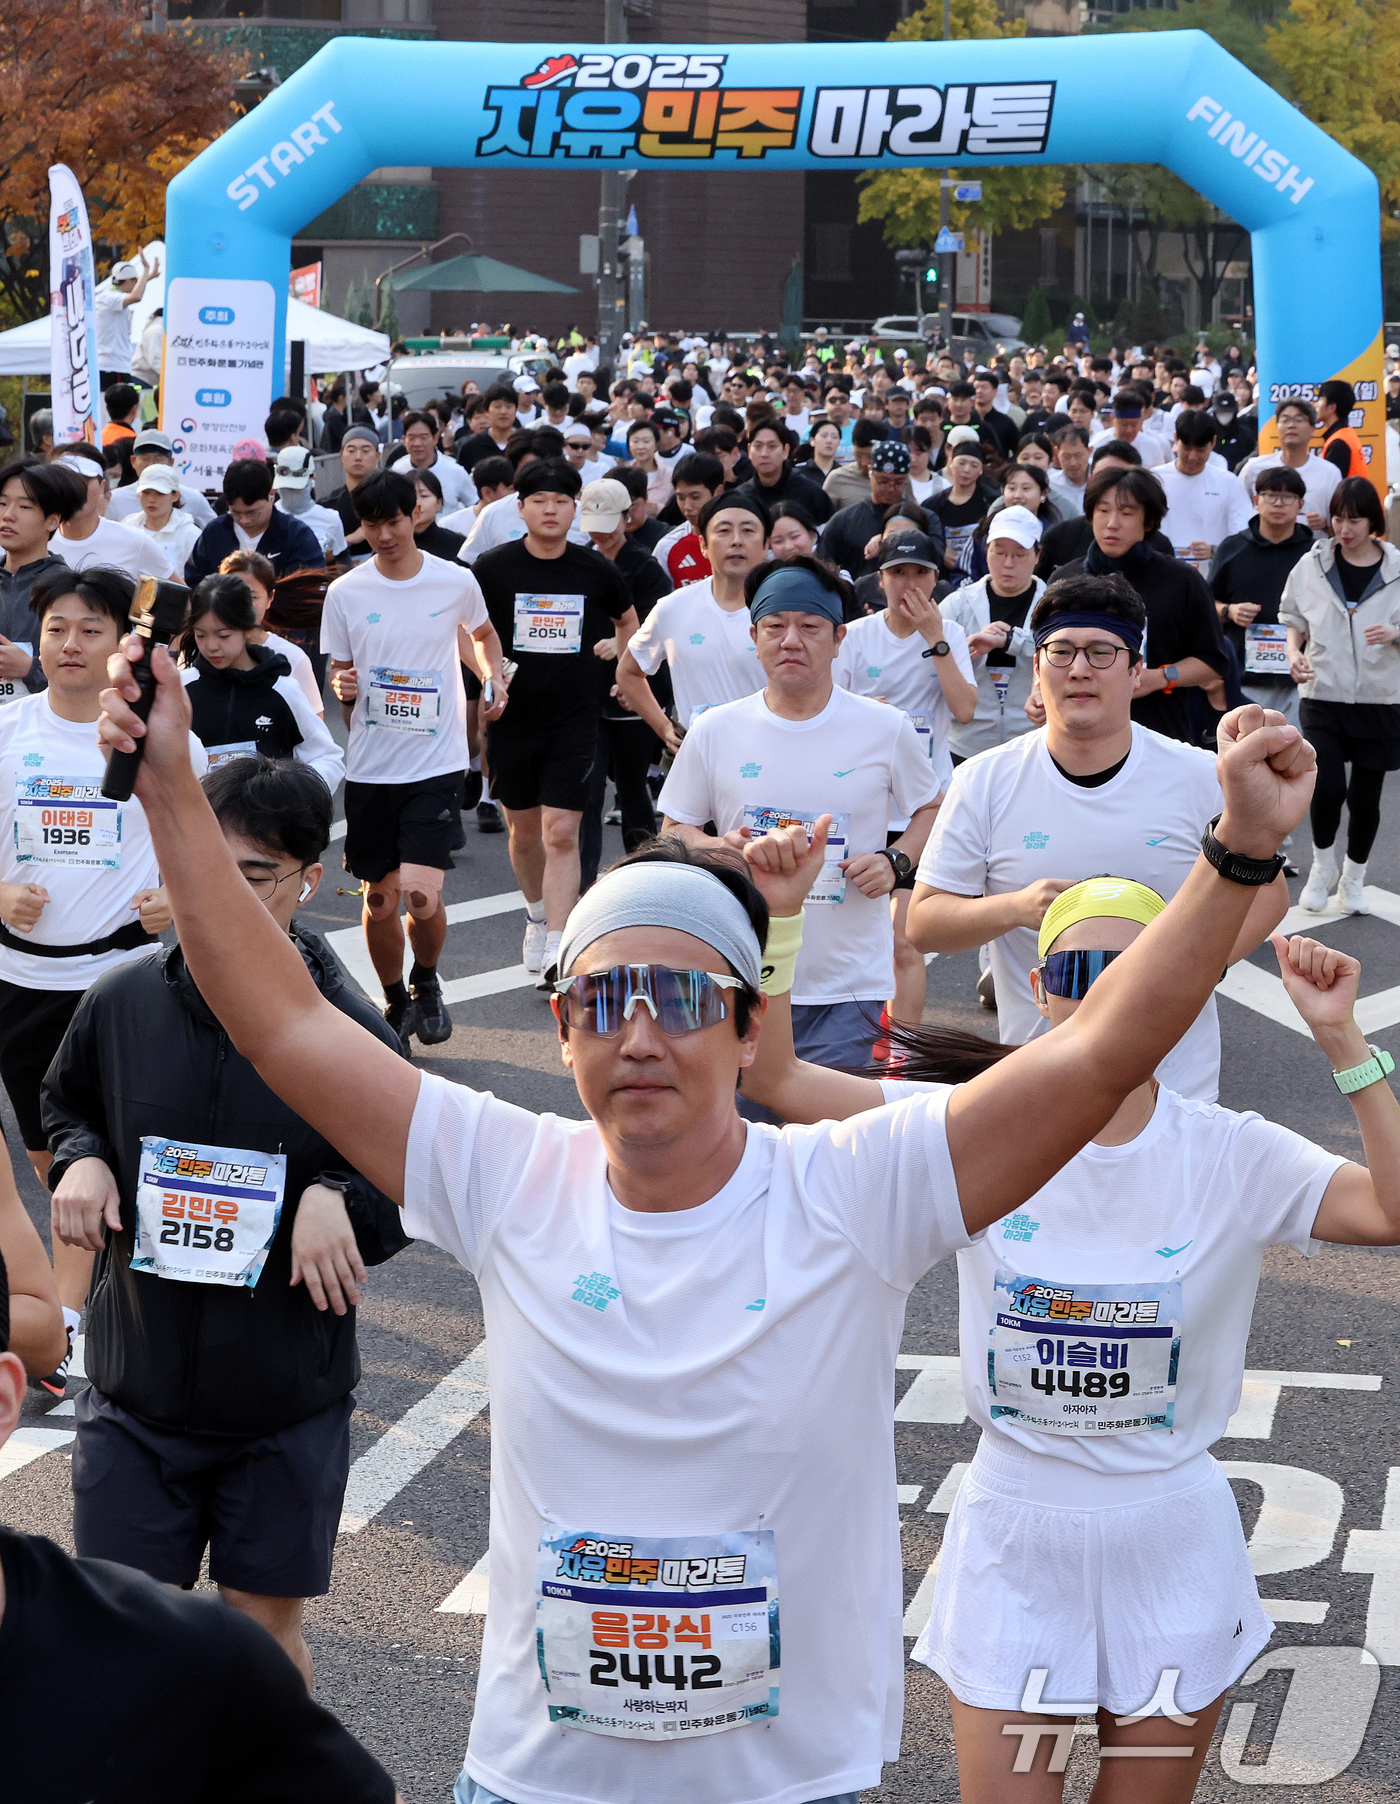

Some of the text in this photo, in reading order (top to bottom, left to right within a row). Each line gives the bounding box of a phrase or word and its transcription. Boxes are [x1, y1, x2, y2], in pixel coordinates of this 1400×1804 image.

[574, 54, 728, 89] 2025
[477, 82, 1055, 158] 자유민주 마라톤
[226, 100, 343, 211] START
[1185, 95, 1315, 204] FINISH
[205, 310, 229, 322] 주최
[1270, 383, 1322, 402] 2025.
[202, 422, 246, 433] 행정안전부
[193, 465, 225, 477] 서울특
[532, 616, 565, 628] 한민규
[529, 627, 567, 639] 2054
[1256, 651, 1286, 662] 2250
[385, 691, 422, 706] 김주환
[384, 703, 421, 718] 1654
[25, 785, 73, 798] 자유민주
[41, 809, 93, 828] 이태희
[769, 811, 792, 820] 2025
[42, 828, 91, 846] 1936
[166, 1146, 198, 1160] 2025
[153, 1155, 268, 1186] 자유민주 마라톤
[162, 1193, 239, 1225] 김민우
[1001, 1218, 1040, 1231] 자유민주
[160, 1220, 234, 1252] 2158
[1003, 1229, 1033, 1242] 마라톤
[572, 1274, 622, 1300] 자유민주
[1035, 1285, 1074, 1300] 2025
[571, 1288, 609, 1312] 마라톤
[1010, 1292, 1159, 1323] 자유민주 마라톤
[1000, 1317, 1021, 1328] 10KM
[1013, 1353, 1032, 1363] C152
[1036, 1338, 1128, 1369] 이슬비
[1031, 1368, 1130, 1398] 4489
[1063, 1404, 1097, 1415] 아자아자
[1097, 1413, 1167, 1430] 민주화운동기념관
[585, 1540, 633, 1559] 2025
[556, 1550, 747, 1587] 자유민주 마라톤
[546, 1585, 572, 1597] 10KM
[591, 1611, 712, 1650] 음강식
[731, 1622, 757, 1633] C156
[589, 1650, 722, 1690] 2442
[623, 1699, 688, 1714] 사랑하는딱지
[679, 1703, 769, 1731] 민주화운동기념관
